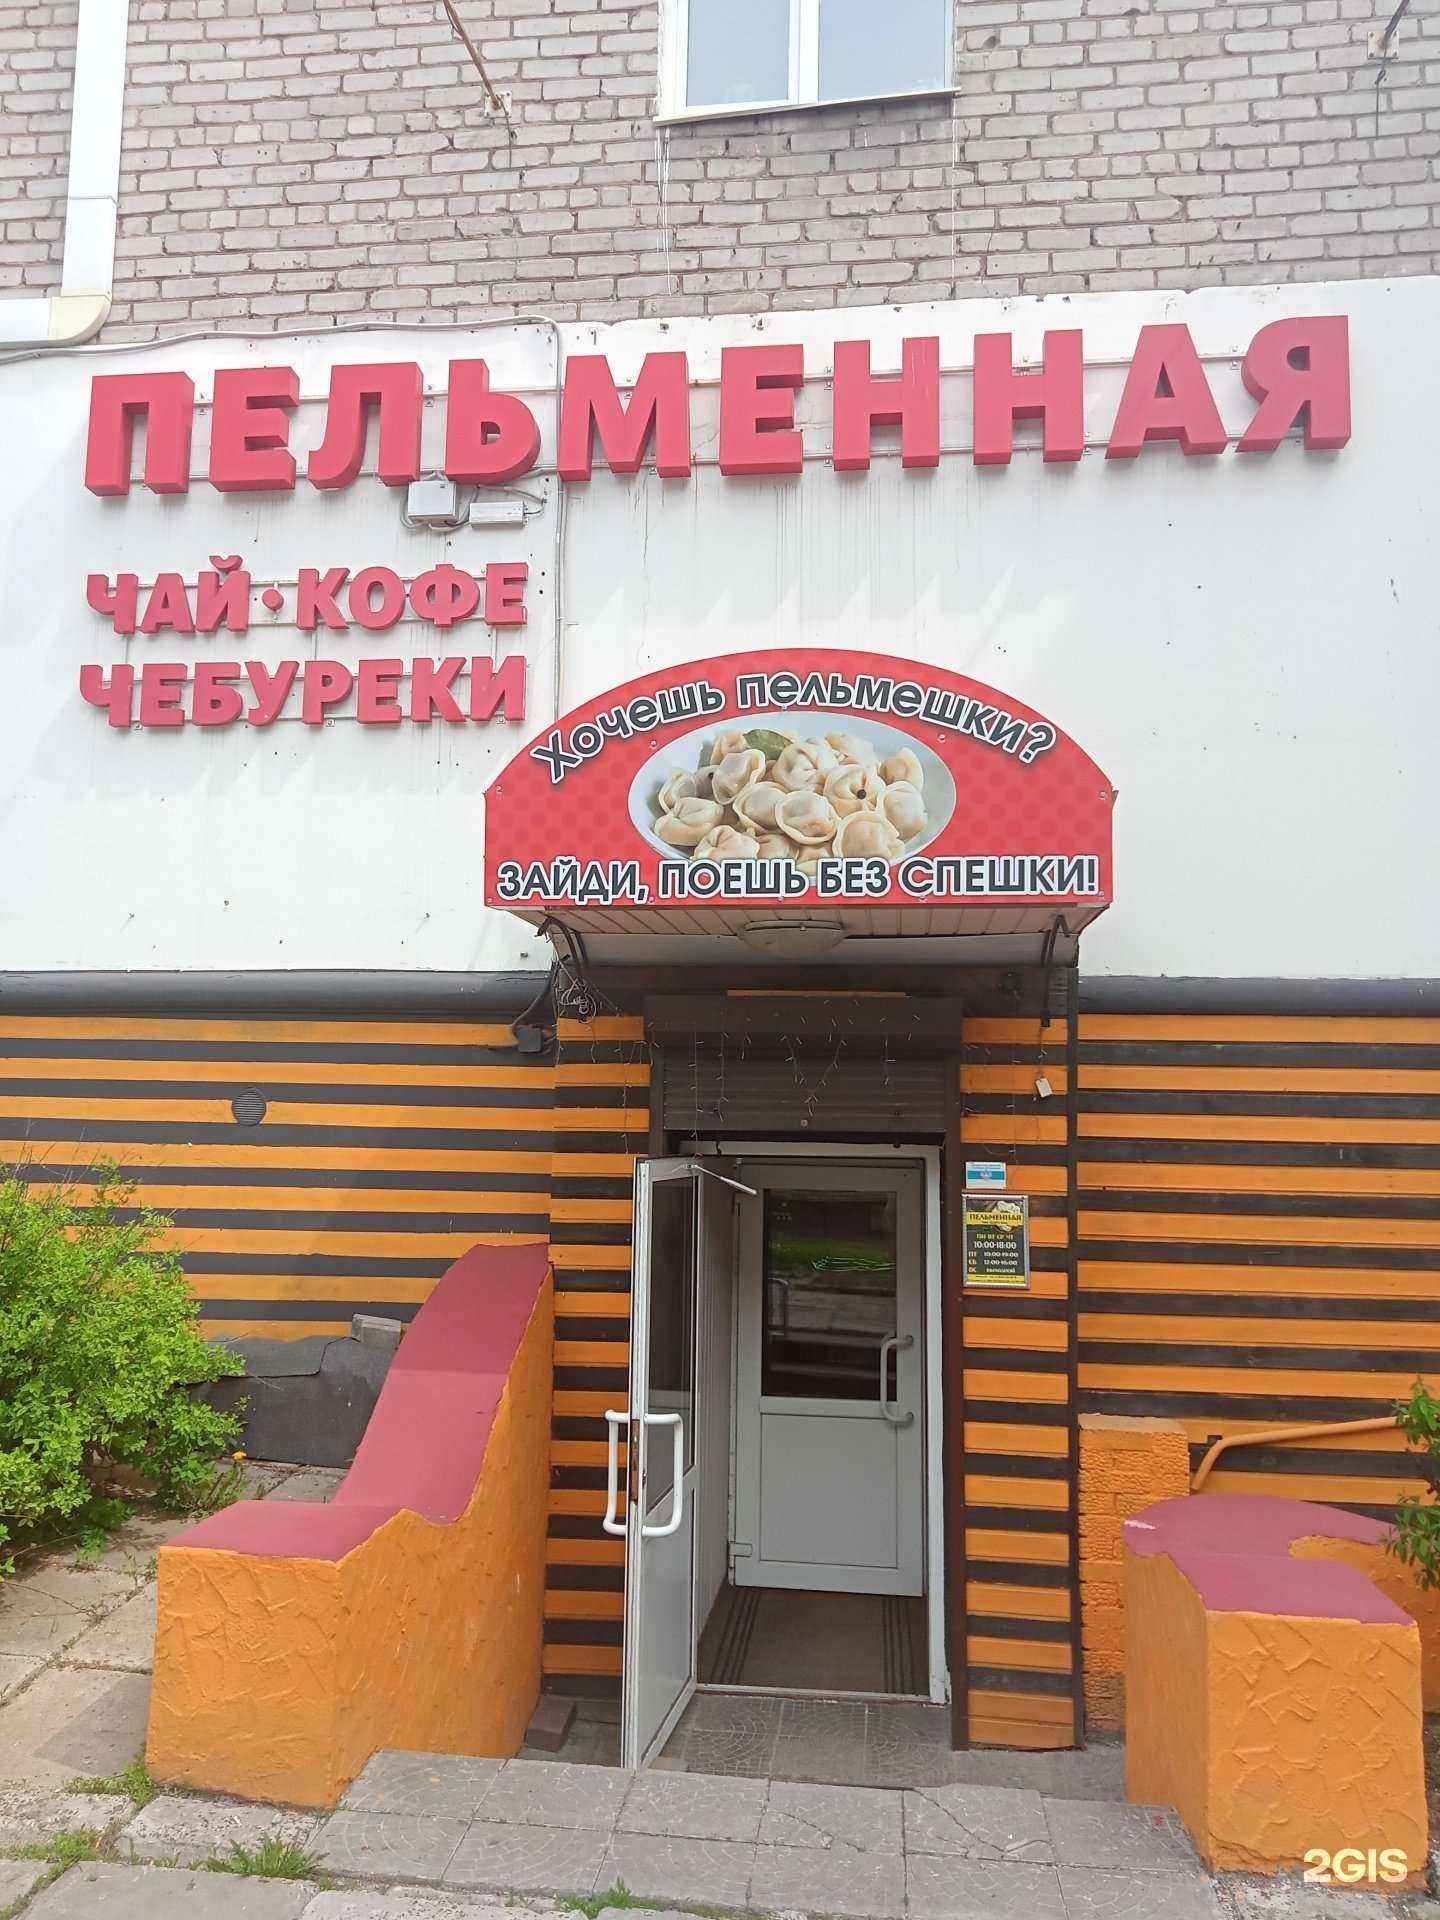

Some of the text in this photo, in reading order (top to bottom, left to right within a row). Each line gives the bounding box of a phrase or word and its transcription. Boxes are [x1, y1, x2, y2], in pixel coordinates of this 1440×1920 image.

[85, 315, 1351, 496] ПЕЛЬМЕННАЯ
[86, 555, 529, 634] ЧАЙ КОФЕ
[80, 656, 527, 727] ЧЕБУРЕКИ
[531, 671, 1058, 784] Хочешь пельмешки?
[497, 856, 1098, 901] ЗАЙДИ, ПОЕШЬ БЕЗ СПЕШКИ!
[969, 1212, 1022, 1221] ПЕЛЬМЕННАЯ
[974, 1241, 1017, 1249] 10:00-18:00
